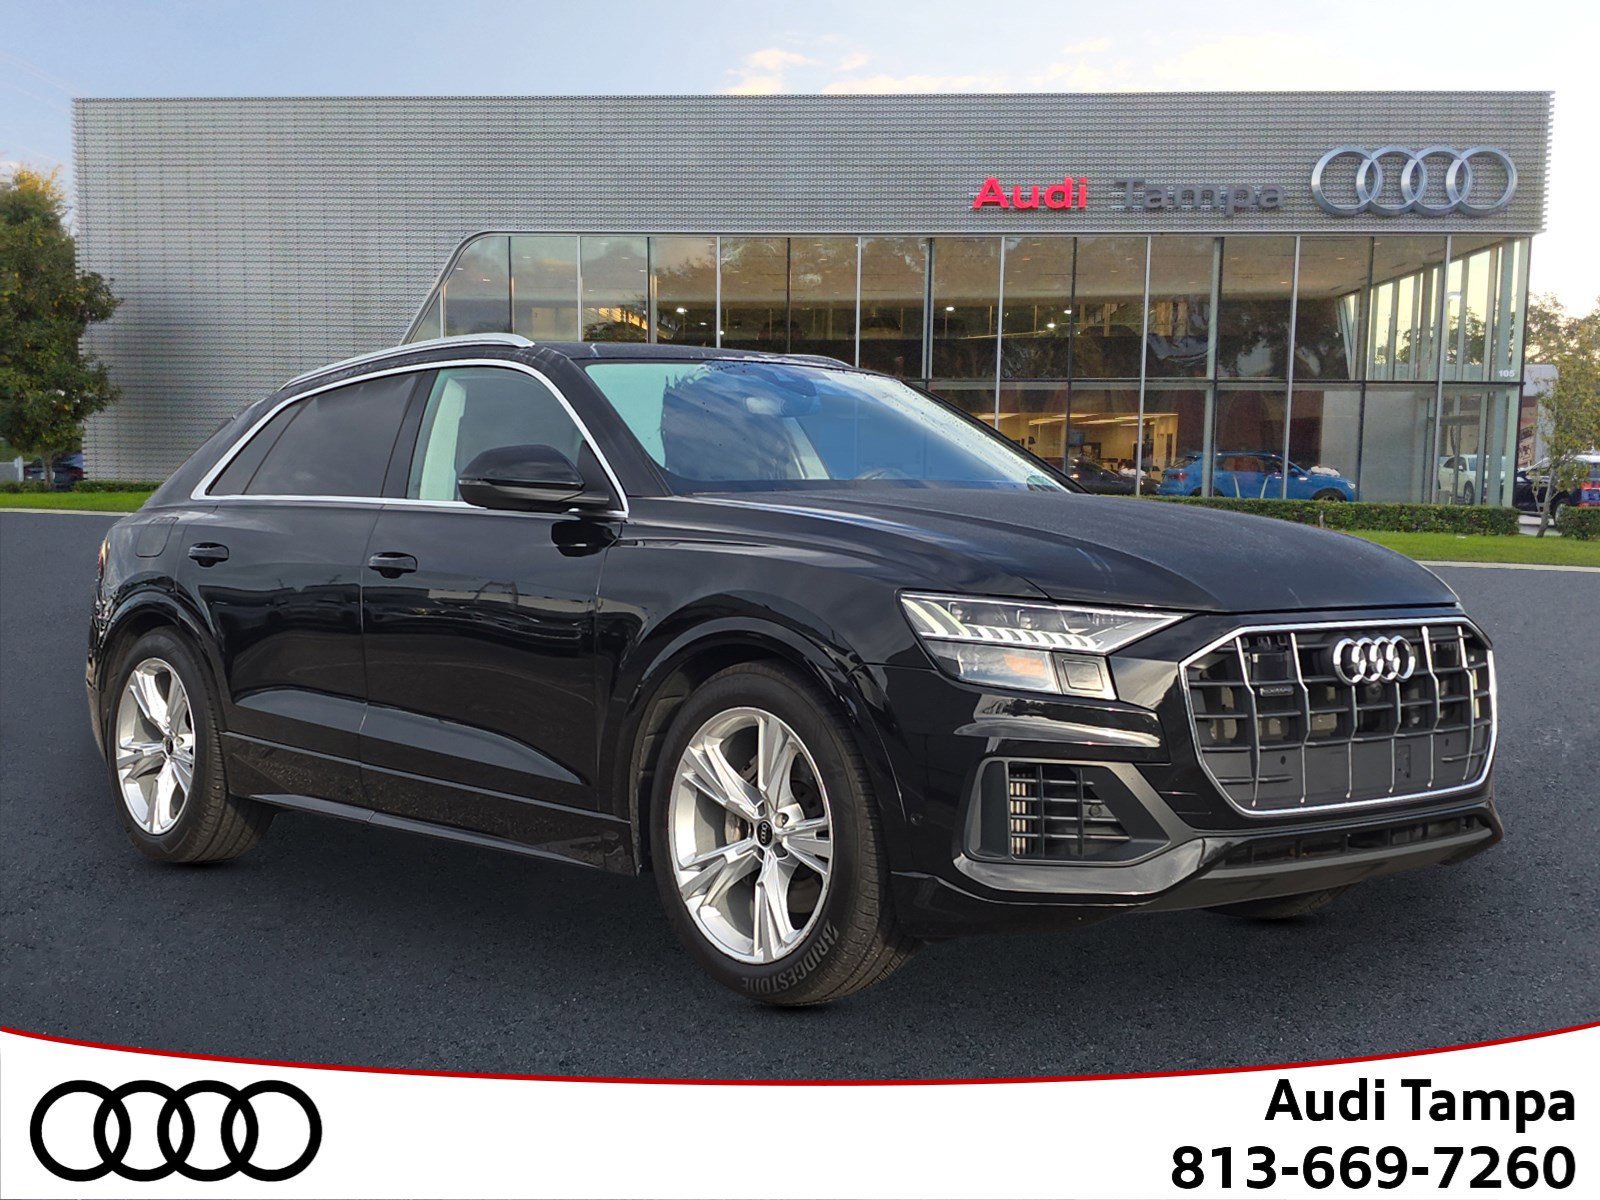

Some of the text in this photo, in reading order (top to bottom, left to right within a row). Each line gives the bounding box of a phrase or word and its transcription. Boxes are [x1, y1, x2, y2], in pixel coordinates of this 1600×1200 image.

[972, 176, 1285, 218] Audi Tampa
[741, 919, 839, 994] BRIDGESTONE
